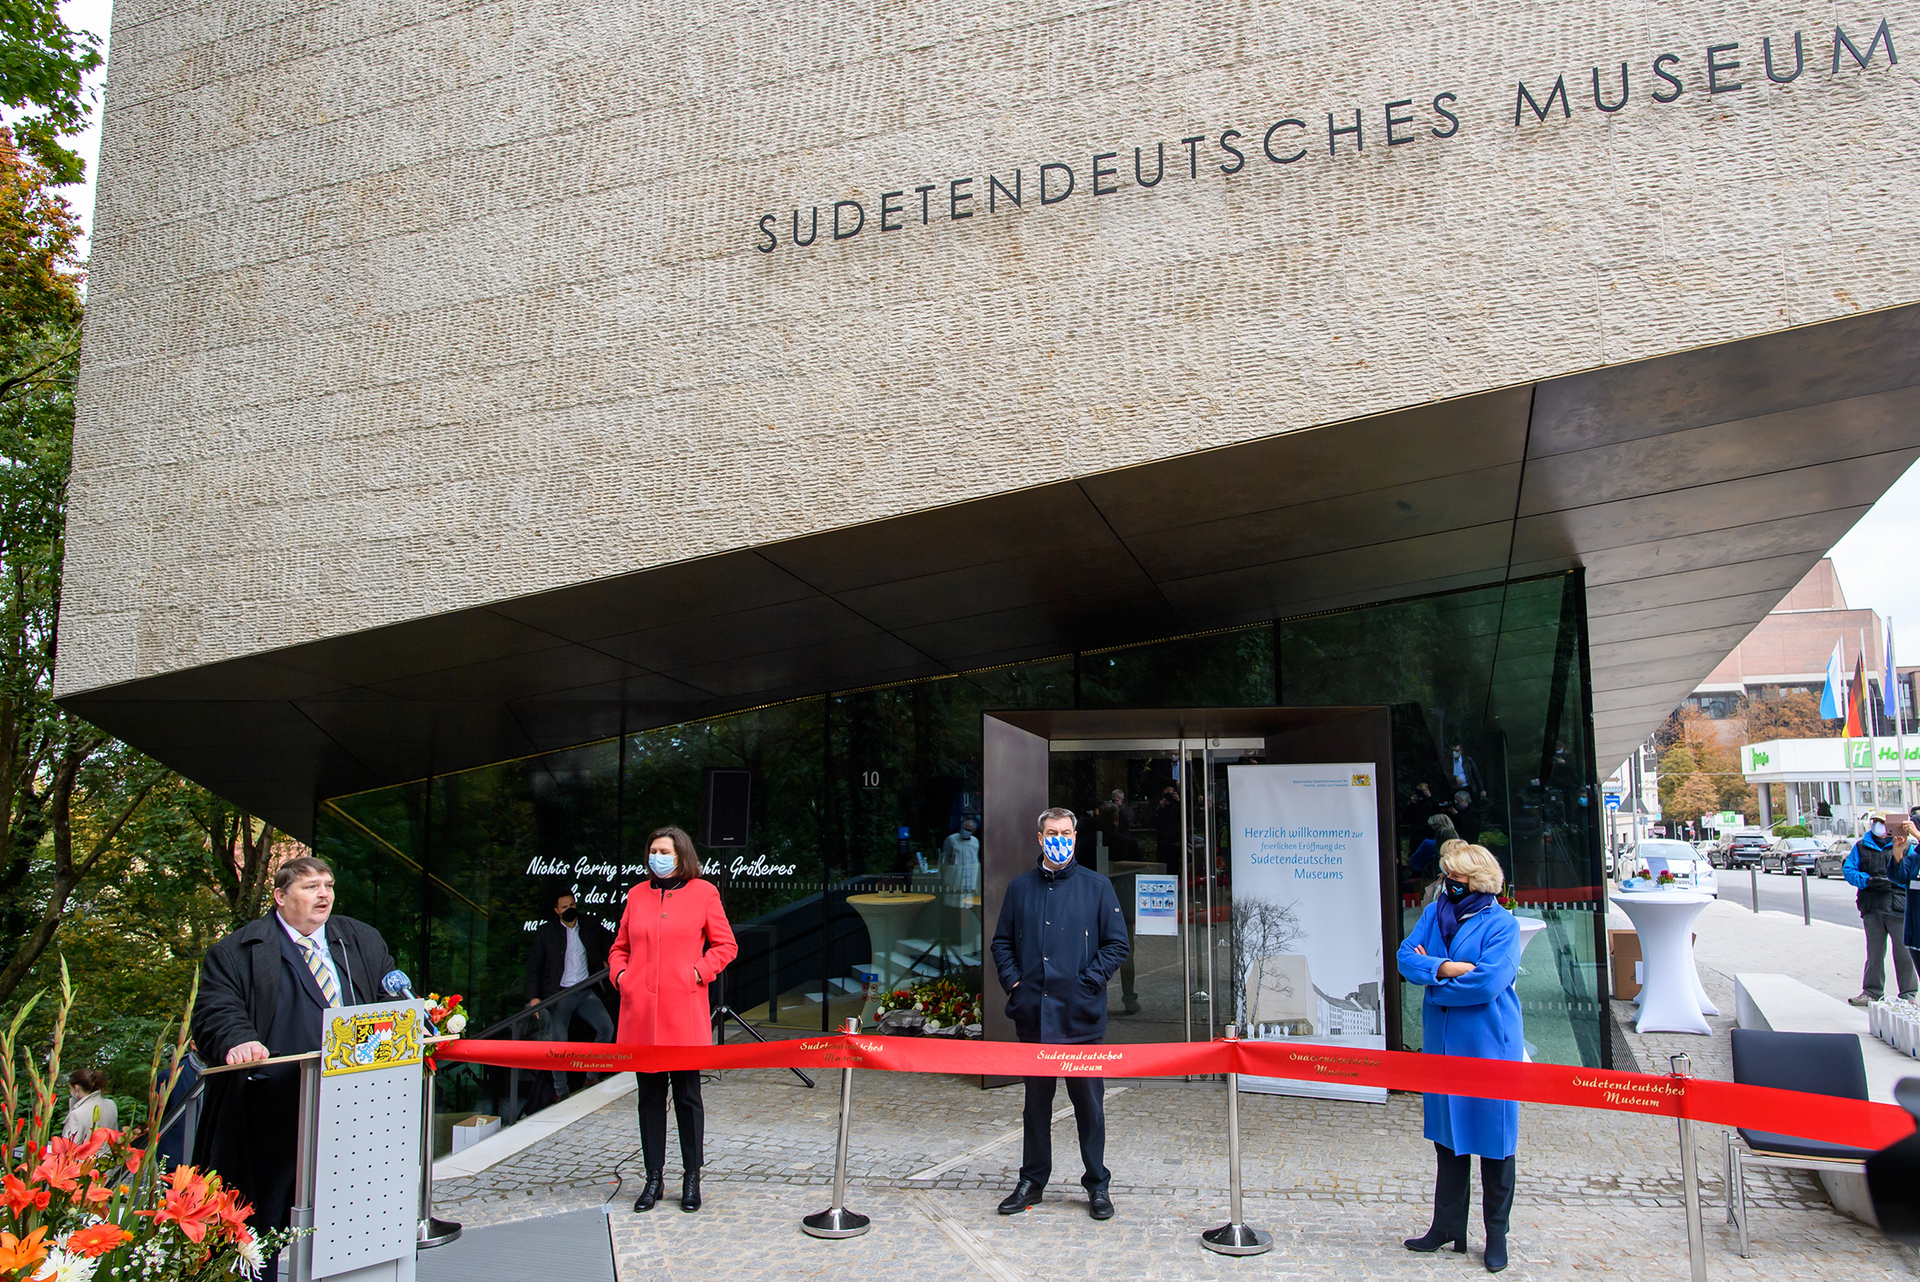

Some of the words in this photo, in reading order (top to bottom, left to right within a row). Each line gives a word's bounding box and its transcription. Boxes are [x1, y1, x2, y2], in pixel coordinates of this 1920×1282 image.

[757, 93, 1461, 252] SUDETENDEUTSCHES
[1515, 18, 1898, 128] MUSEUM
[1878, 746, 1920, 760] Hoid
[862, 771, 880, 787] 10
[1244, 827, 1286, 838] Herzlich
[1288, 827, 1350, 838] willkommen
[1260, 842, 1297, 852] feierlichen
[1298, 842, 1333, 852] Eröffnung
[1334, 842, 1346, 850] des
[1250, 853, 1343, 865] Sudetendeutschen
[526, 856, 570, 875] Nichts
[729, 854, 797, 880] Größeres
[1294, 868, 1344, 880] Museums
[584, 885, 608, 904] das
[546, 1048, 633, 1061] Sudetendeutsches
[823, 1052, 863, 1063] Museum
[1037, 1050, 1123, 1061] Sudetendeutsches
[1289, 1050, 1381, 1067] Sudetendeutsches
[570, 1060, 614, 1069] Museum
[1060, 1061, 1103, 1072] Museum
[1314, 1064, 1359, 1078] Museum
[1572, 1075, 1685, 1097] Sudetendeutsches
[1603, 1091, 1660, 1107] Museum
